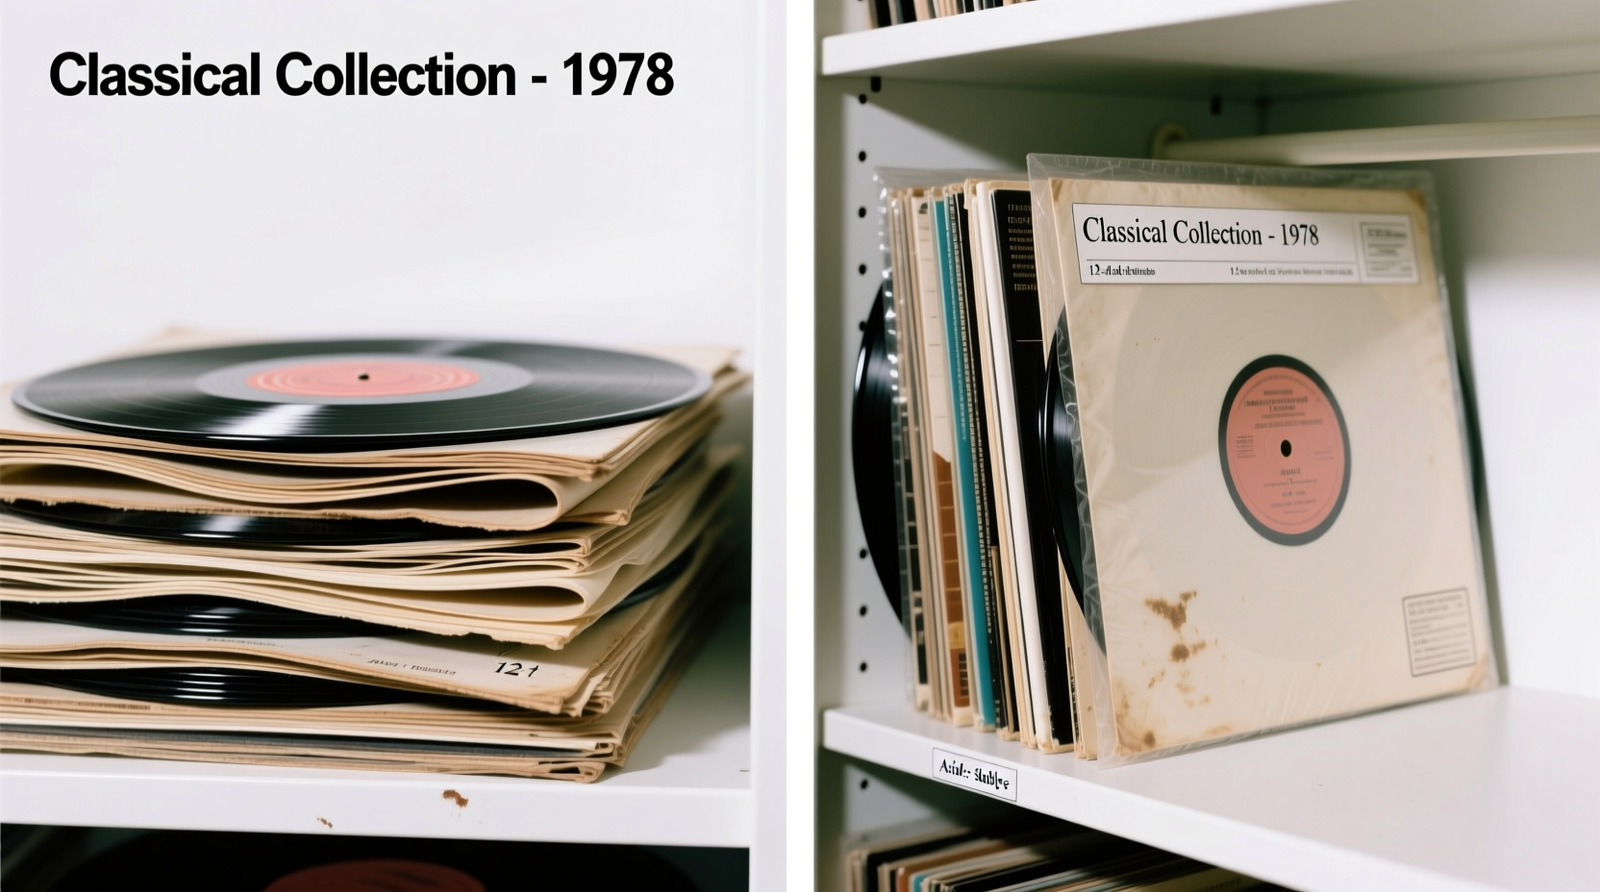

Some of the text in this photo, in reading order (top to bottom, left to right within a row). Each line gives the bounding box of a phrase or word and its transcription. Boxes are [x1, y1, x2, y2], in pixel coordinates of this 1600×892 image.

[1082, 216, 1168, 243] Classical
[1173, 219, 1263, 246] Collection
[1280, 223, 1320, 246] 1978
